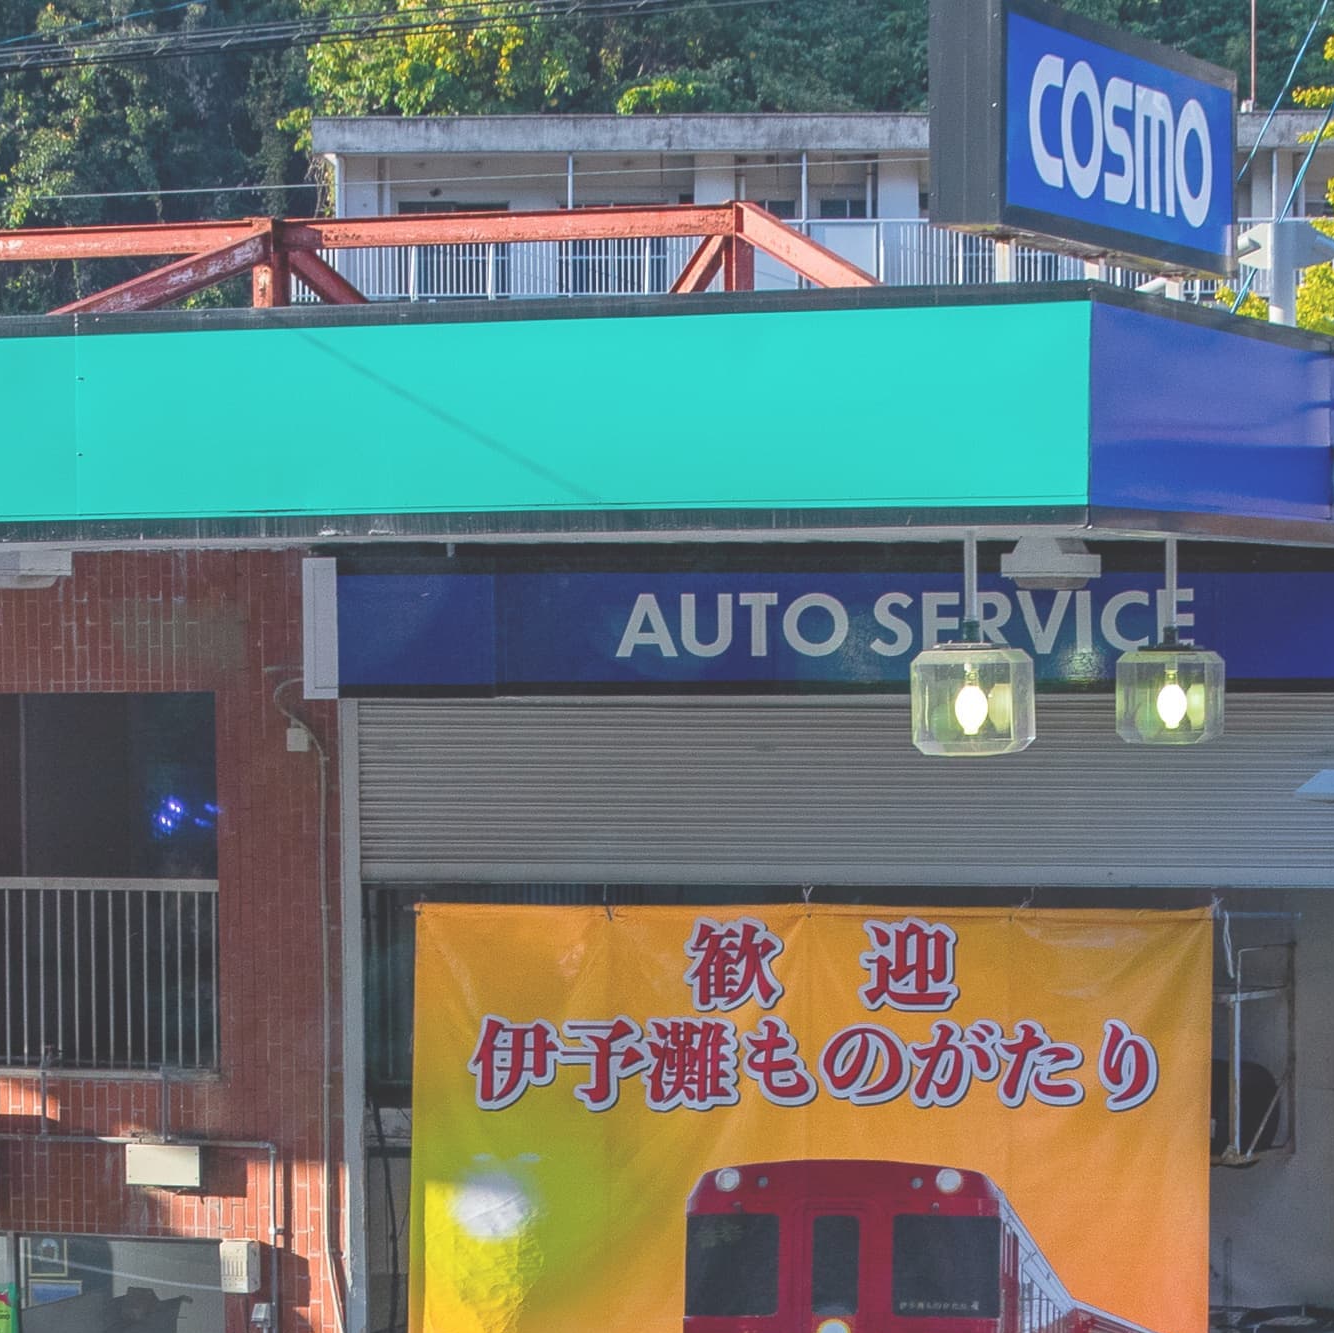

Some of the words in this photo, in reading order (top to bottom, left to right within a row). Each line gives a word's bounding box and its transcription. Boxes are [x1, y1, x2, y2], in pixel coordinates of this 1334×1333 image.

[1029, 54, 1212, 228] COSMO
[616, 593, 849, 657] AUTO
[870, 588, 1194, 657] SERVICE
[691, 918, 959, 1012] 歓迎
[470, 1018, 1158, 1112] 伊予灘ものがたり
